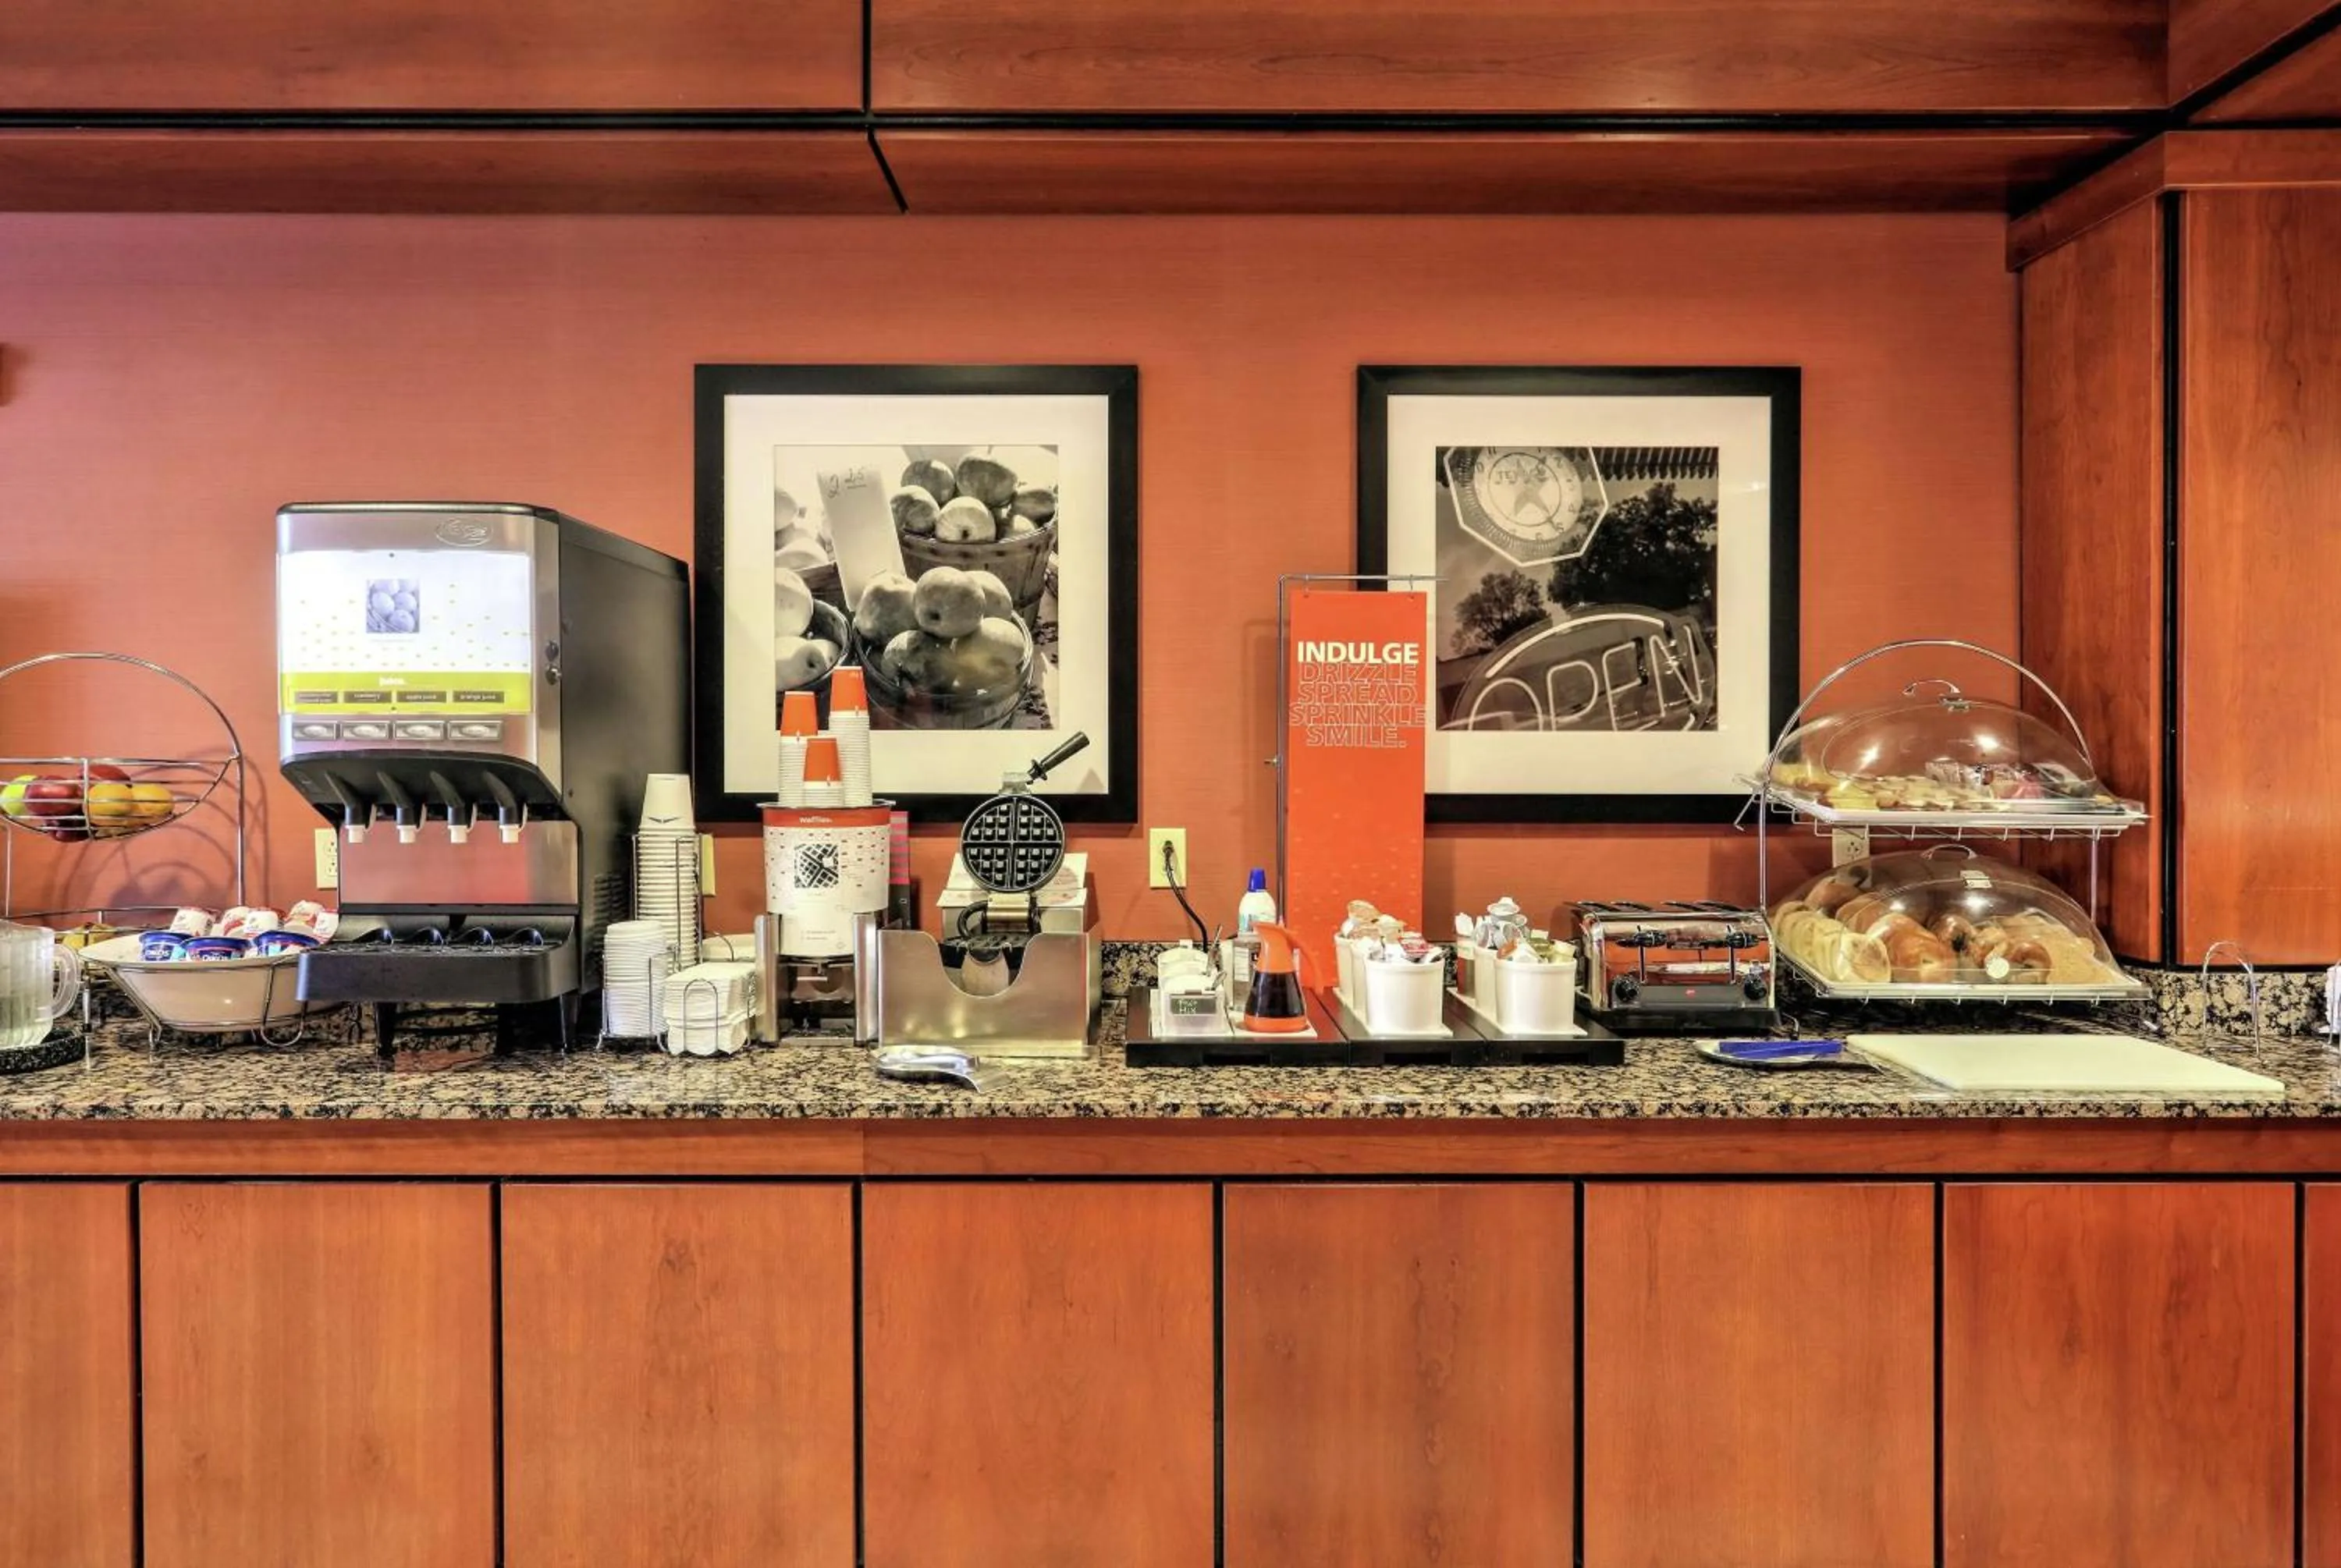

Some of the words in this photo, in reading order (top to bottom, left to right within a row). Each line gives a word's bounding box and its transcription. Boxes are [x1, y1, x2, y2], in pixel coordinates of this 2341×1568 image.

[1298, 641, 1419, 663] INDULGE
[1298, 662, 1418, 684] DRIZZLE
[1468, 625, 1703, 731] OPEN
[1298, 682, 1418, 705] SPREAD
[1289, 702, 1427, 726] SPRINKLE
